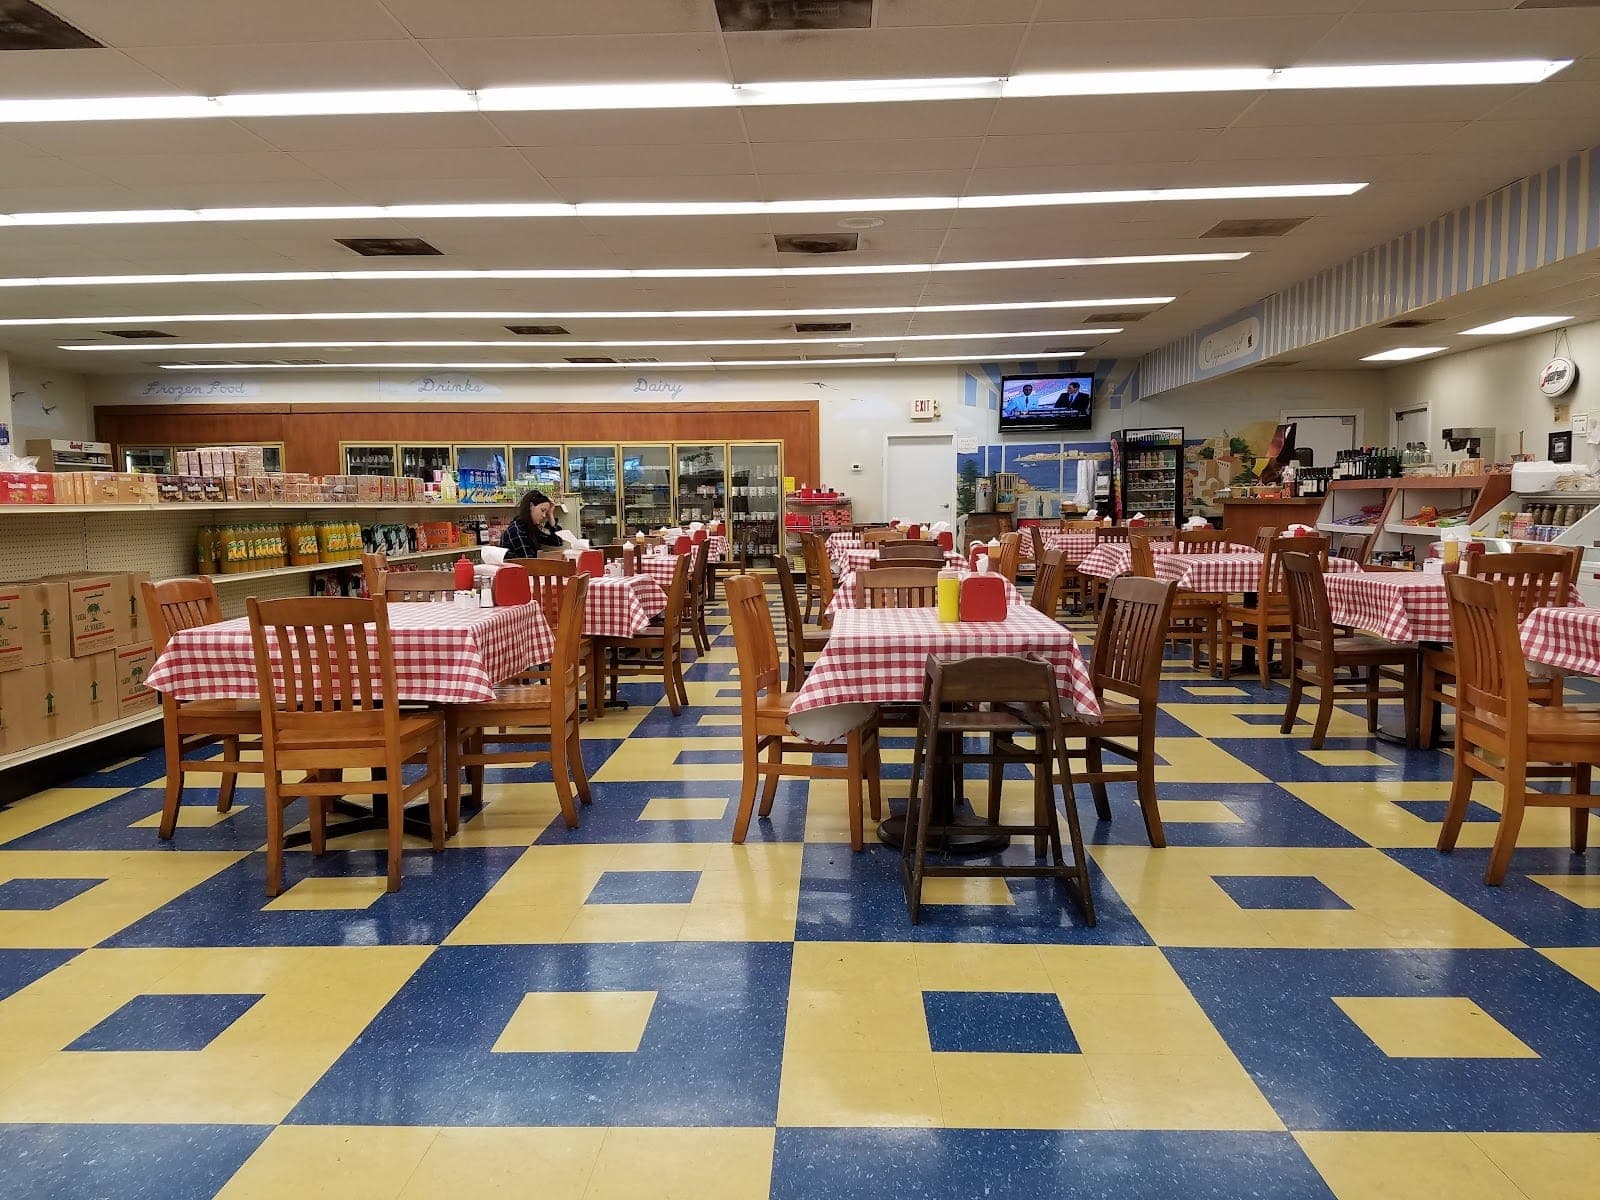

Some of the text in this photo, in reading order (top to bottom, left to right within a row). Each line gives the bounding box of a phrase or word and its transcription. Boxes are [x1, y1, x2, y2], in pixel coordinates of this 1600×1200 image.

[142, 381, 246, 401] Frozen Food
[417, 378, 484, 393] Drinks
[633, 378, 684, 400] Dairy
[914, 399, 931, 413] EXIT
